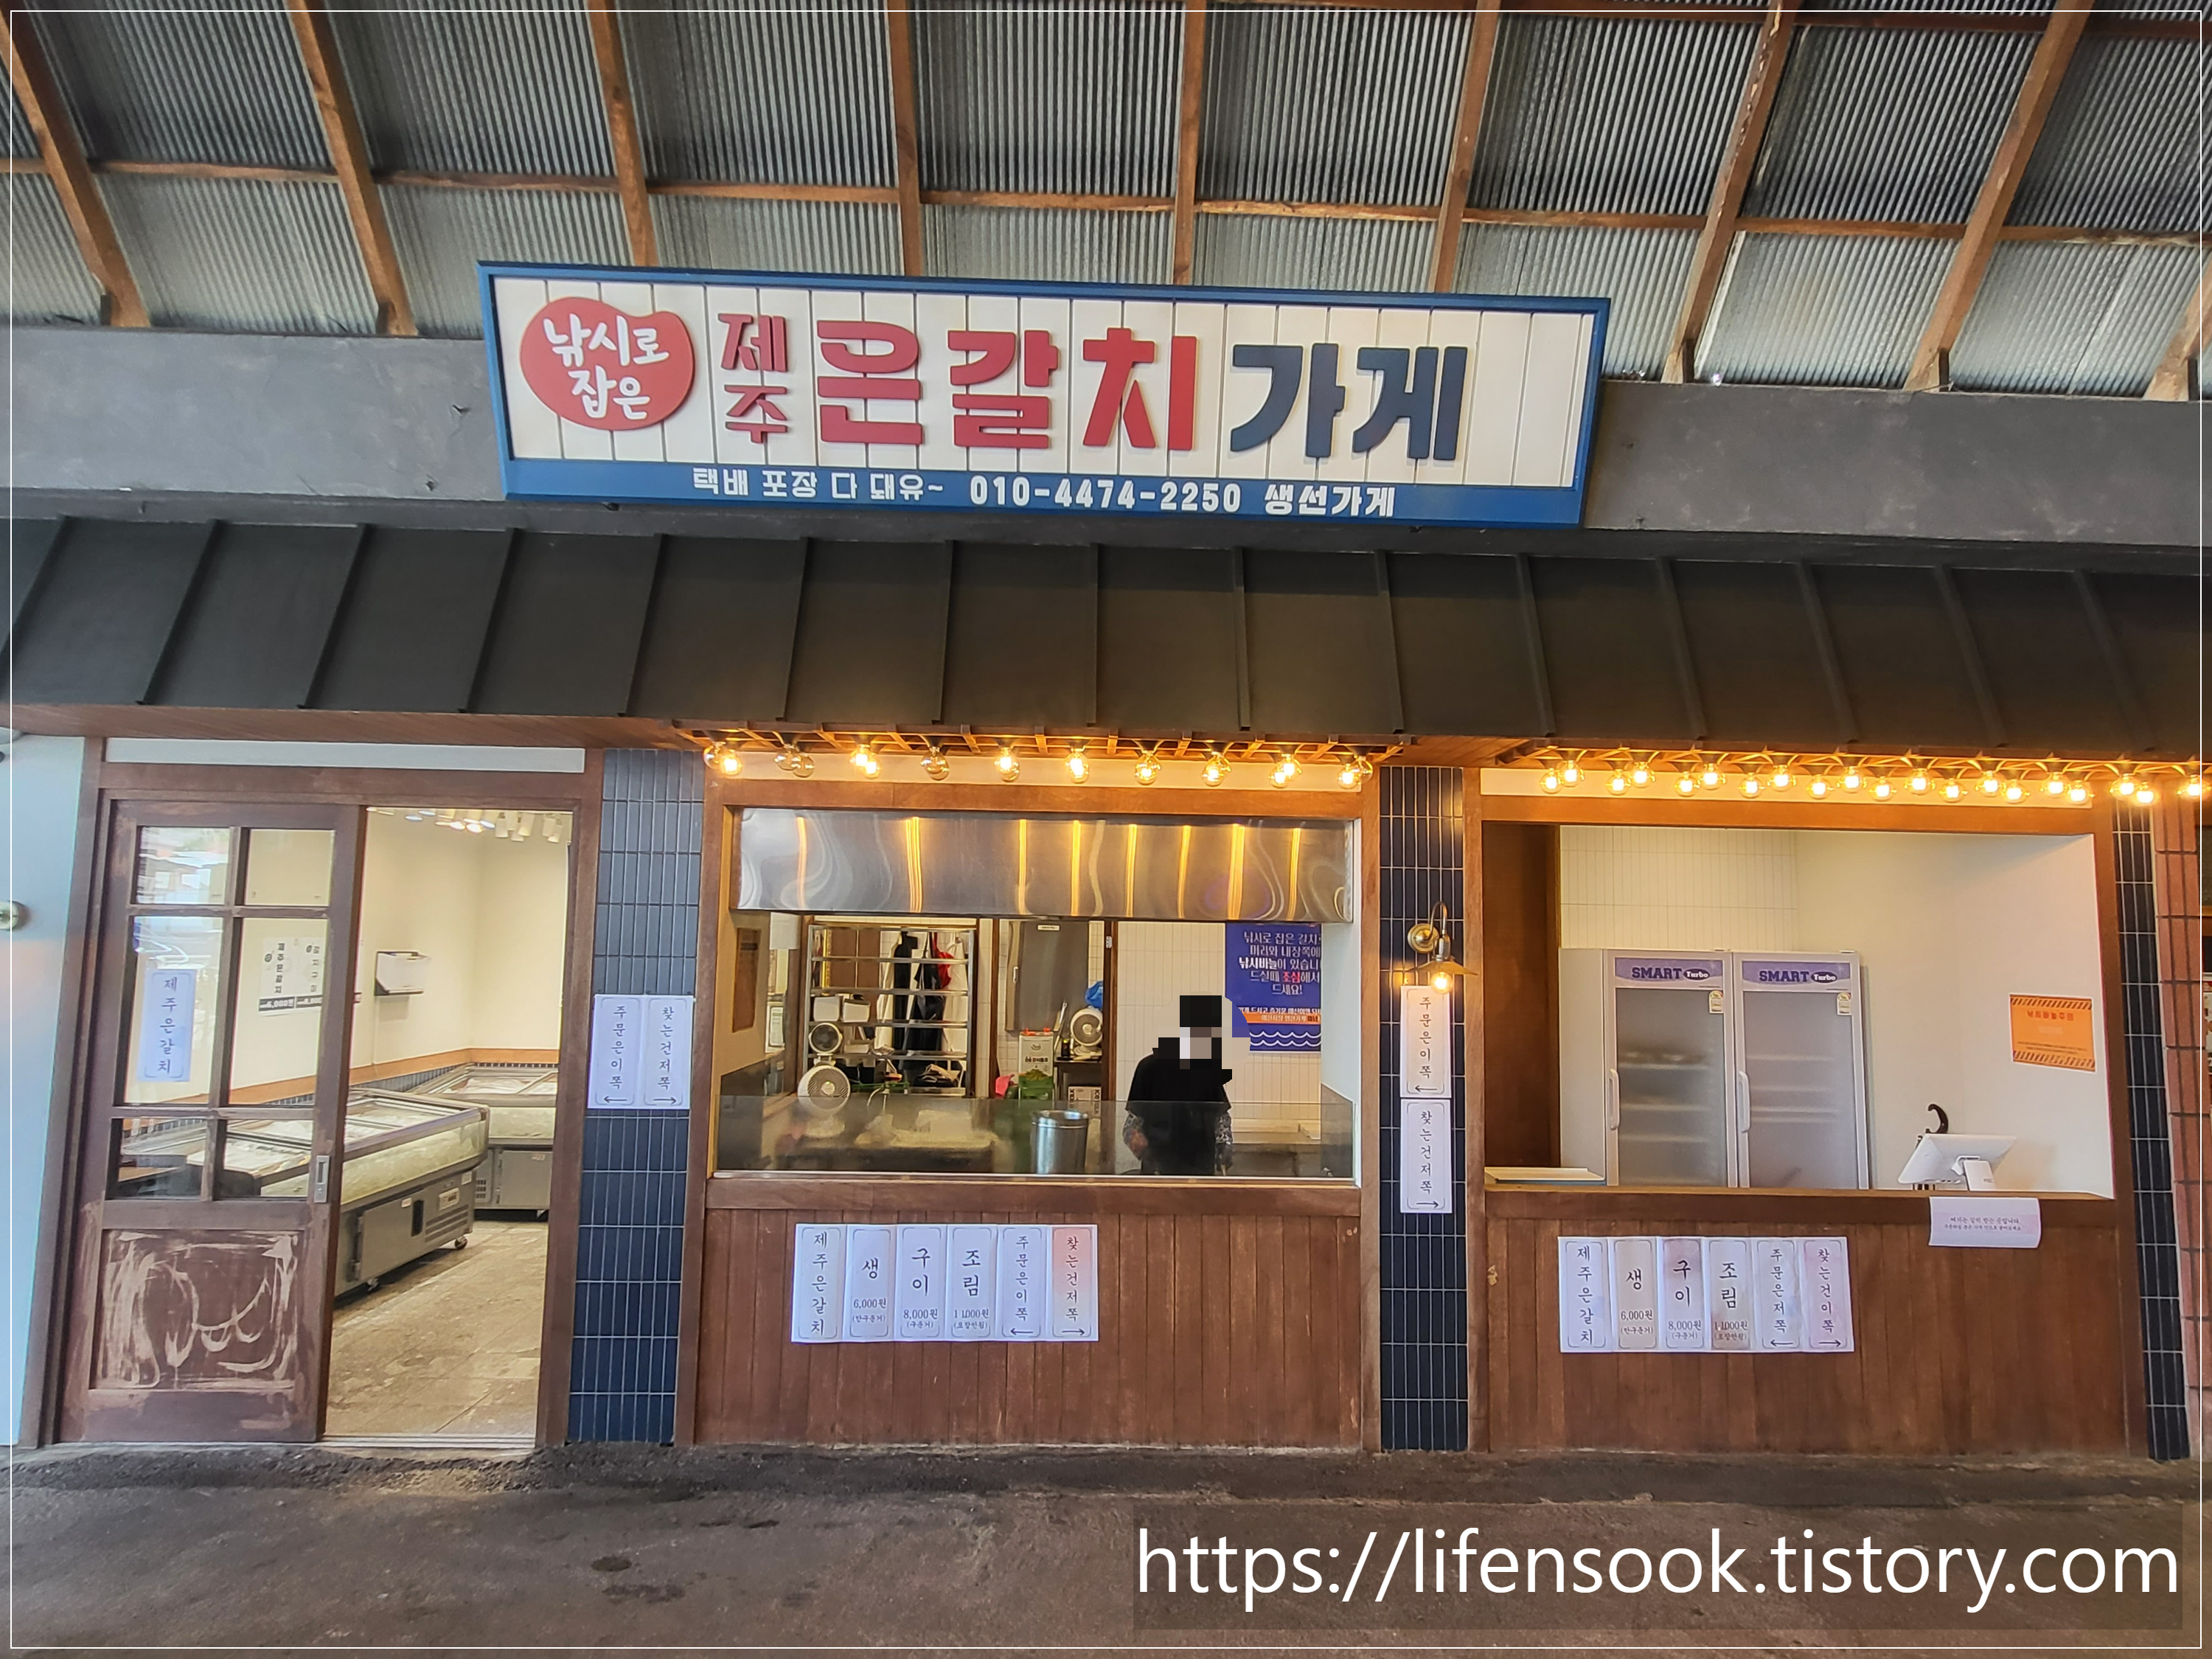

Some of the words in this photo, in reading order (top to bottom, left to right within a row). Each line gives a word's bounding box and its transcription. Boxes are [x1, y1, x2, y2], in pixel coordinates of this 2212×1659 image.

[542, 312, 670, 367] 낚시로
[569, 366, 651, 420] 잡은
[692, 467, 749, 495] 택배
[762, 469, 818, 498] 포장
[831, 472, 858, 499] 다
[970, 474, 1242, 513] 010-4474-2250
[1264, 484, 1396, 518] 생선가게
[1631, 967, 1682, 979] SMART
[1686, 970, 1709, 978] Turbo
[1759, 970, 1809, 982] SMART
[1813, 973, 1836, 981] Turbo
[157, 976, 178, 1074] 제주은갈치
[608, 1006, 627, 1090] 주문은이쪽
[657, 1006, 675, 1091] 찾는건저쪽
[1419, 997, 1432, 1079] 주문은이쪽
[1419, 1110, 1433, 1194] 찾는건저쪽
[810, 1231, 828, 1336] 제주은갈치
[861, 1258, 880, 1279] 생
[911, 1248, 931, 1296] 구이
[961, 1249, 981, 1297] 조림
[1015, 1236, 1029, 1322] 주문은이쪽
[1065, 1236, 1079, 1322] 찾는건저쪽
[1626, 1268, 1642, 1290] 생
[1673, 1259, 1691, 1307] 구이
[1718, 1262, 1738, 1309] 조림
[1770, 1248, 1787, 1333] 주문은저쪽
[1818, 1248, 1834, 1333] 찾는건이쪽
[853, 1298, 887, 1310] 6,000원
[903, 1309, 939, 1320] 8,000원
[1576, 1246, 1594, 1346] 제주은갈치
[1621, 1310, 1653, 1321] 6,000원
[1668, 1319, 1702, 1331] 8,000원
